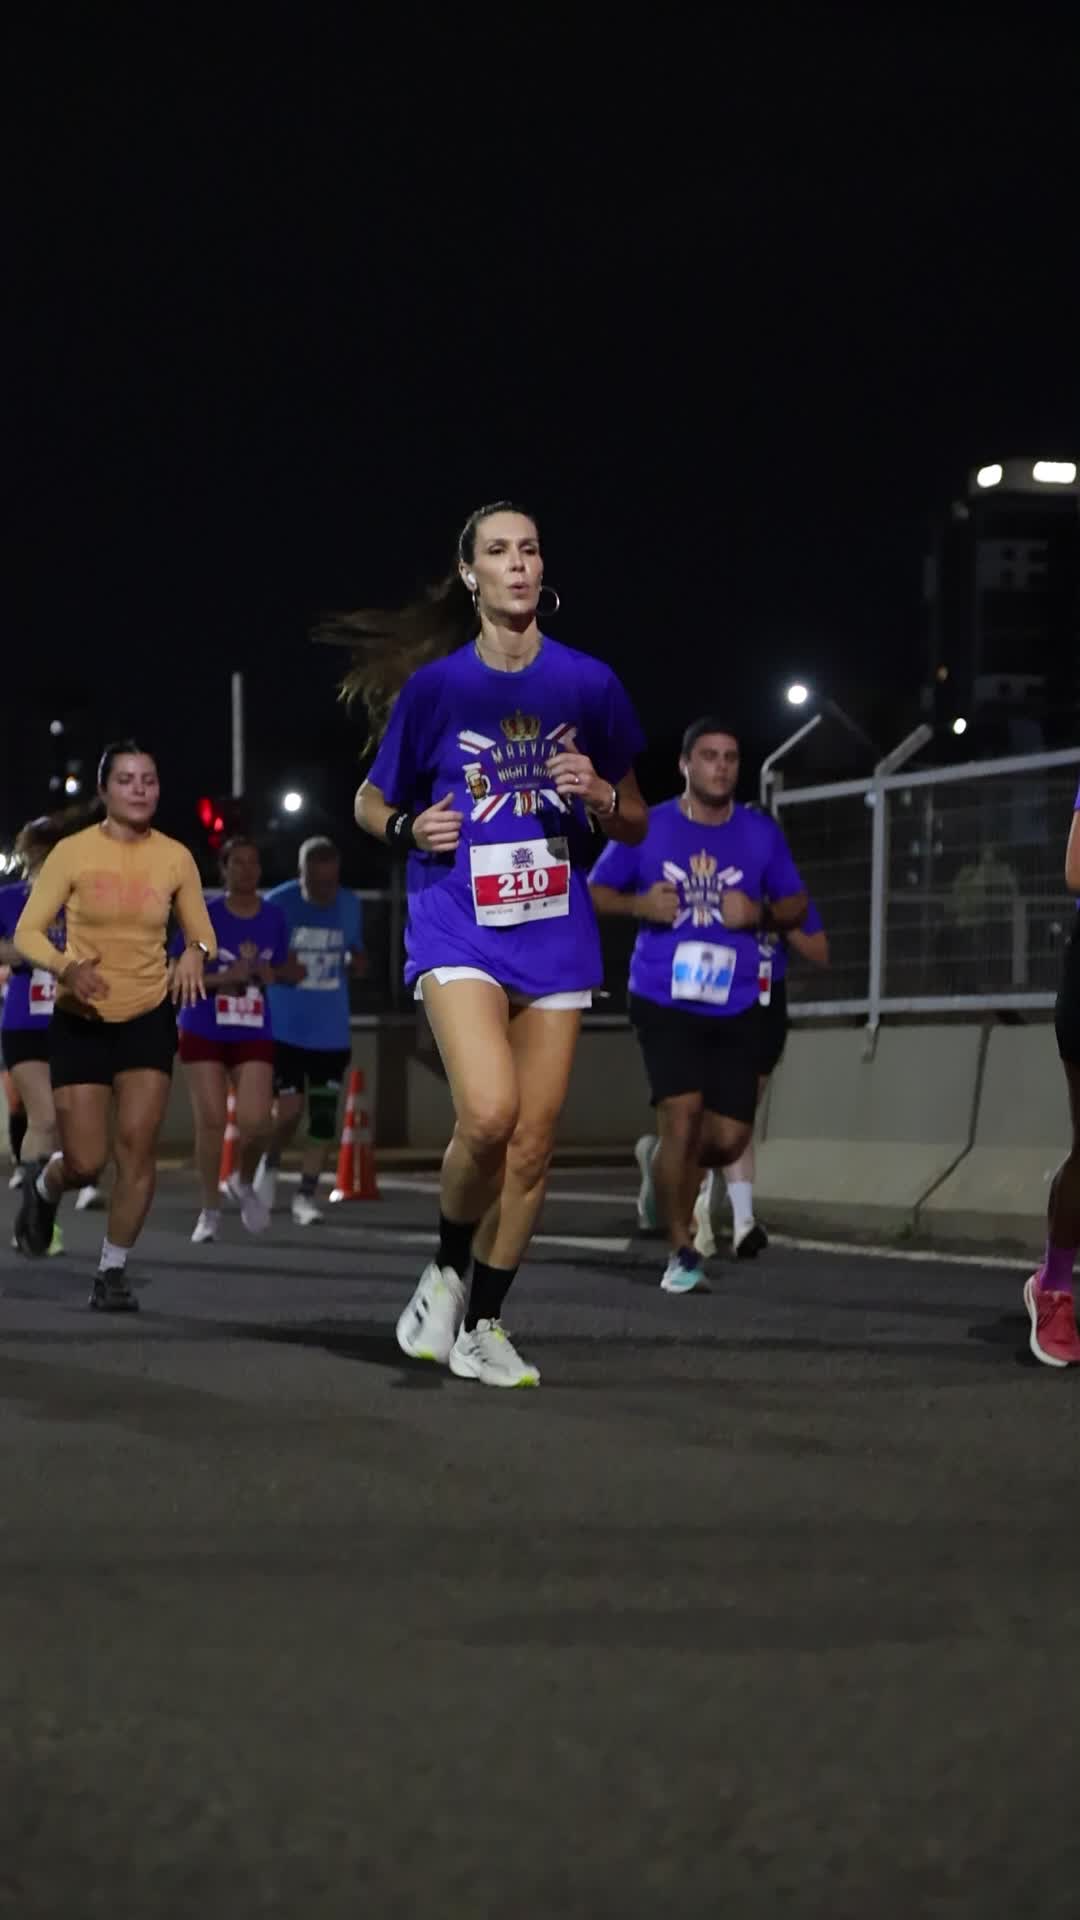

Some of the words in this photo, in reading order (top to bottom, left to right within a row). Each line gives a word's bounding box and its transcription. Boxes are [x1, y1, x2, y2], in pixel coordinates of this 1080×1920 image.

[491, 742, 557, 764] MARVIN
[497, 763, 528, 782] NIGHT
[498, 869, 549, 898] 210
